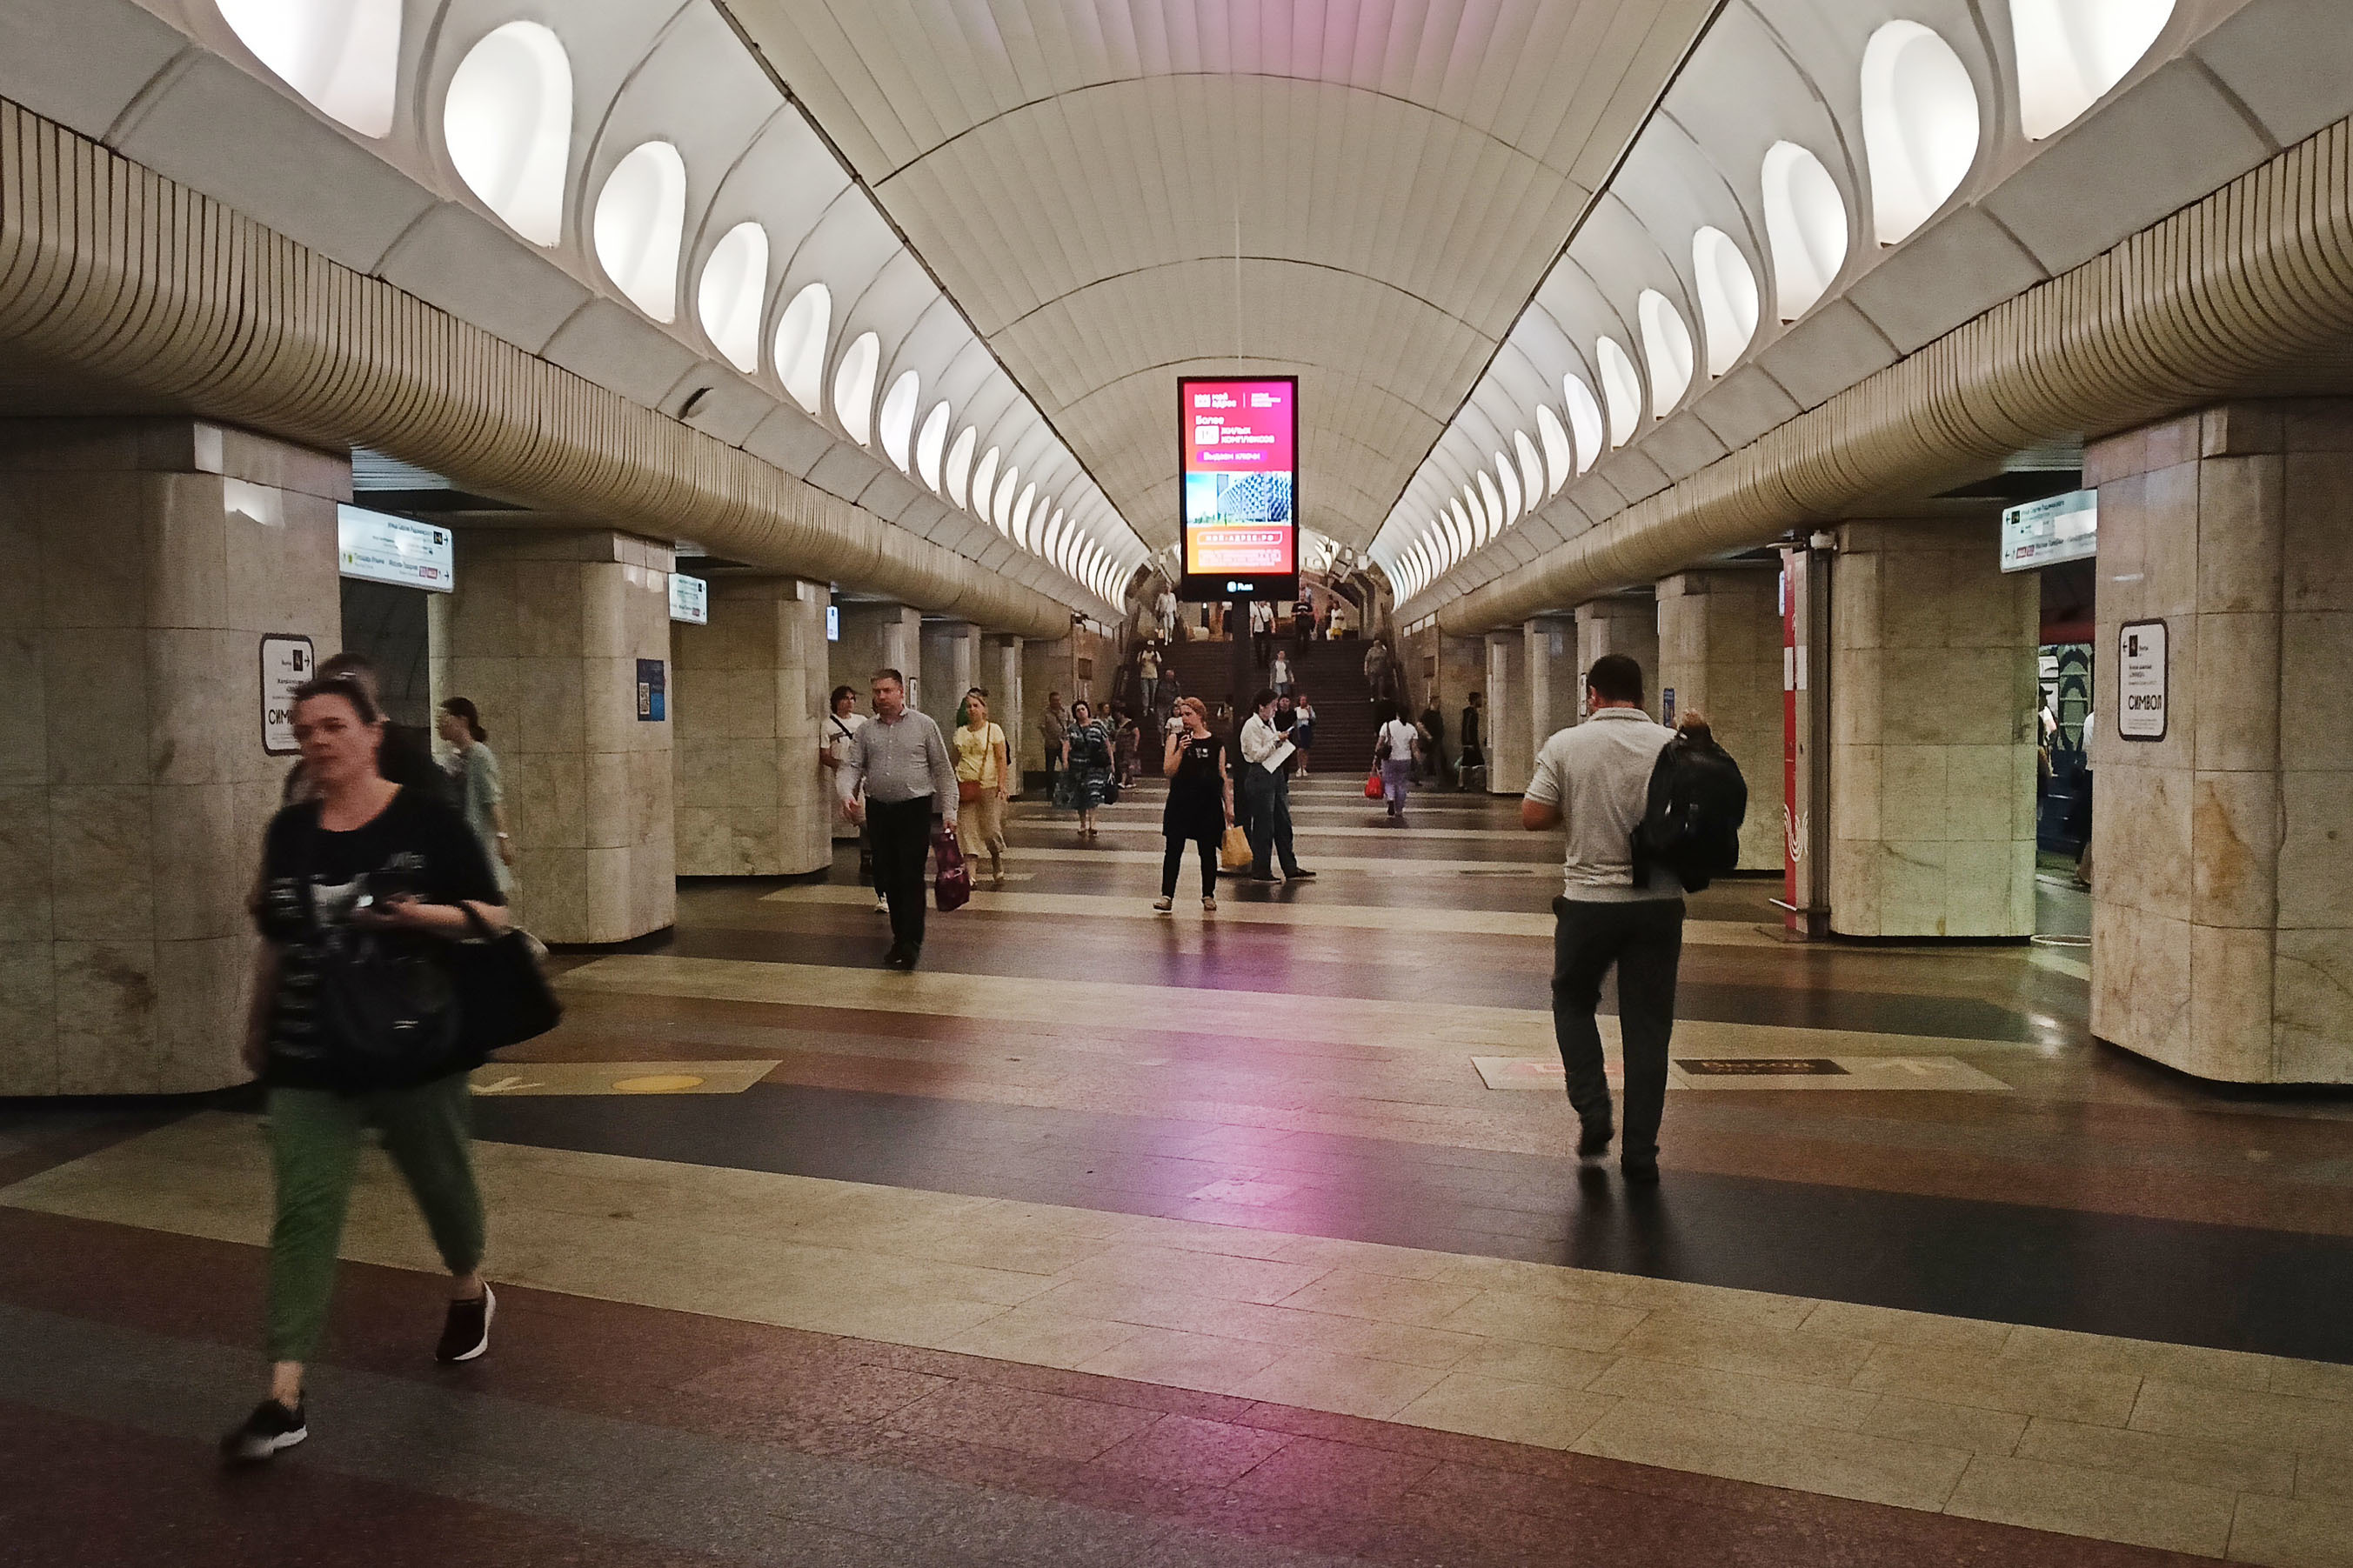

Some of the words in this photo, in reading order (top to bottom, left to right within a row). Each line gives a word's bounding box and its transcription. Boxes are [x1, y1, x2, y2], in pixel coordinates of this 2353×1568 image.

[1195, 415, 1225, 425] Более
[2128, 695, 2162, 711] СИМВОЛ
[268, 709, 293, 725] СИМ
